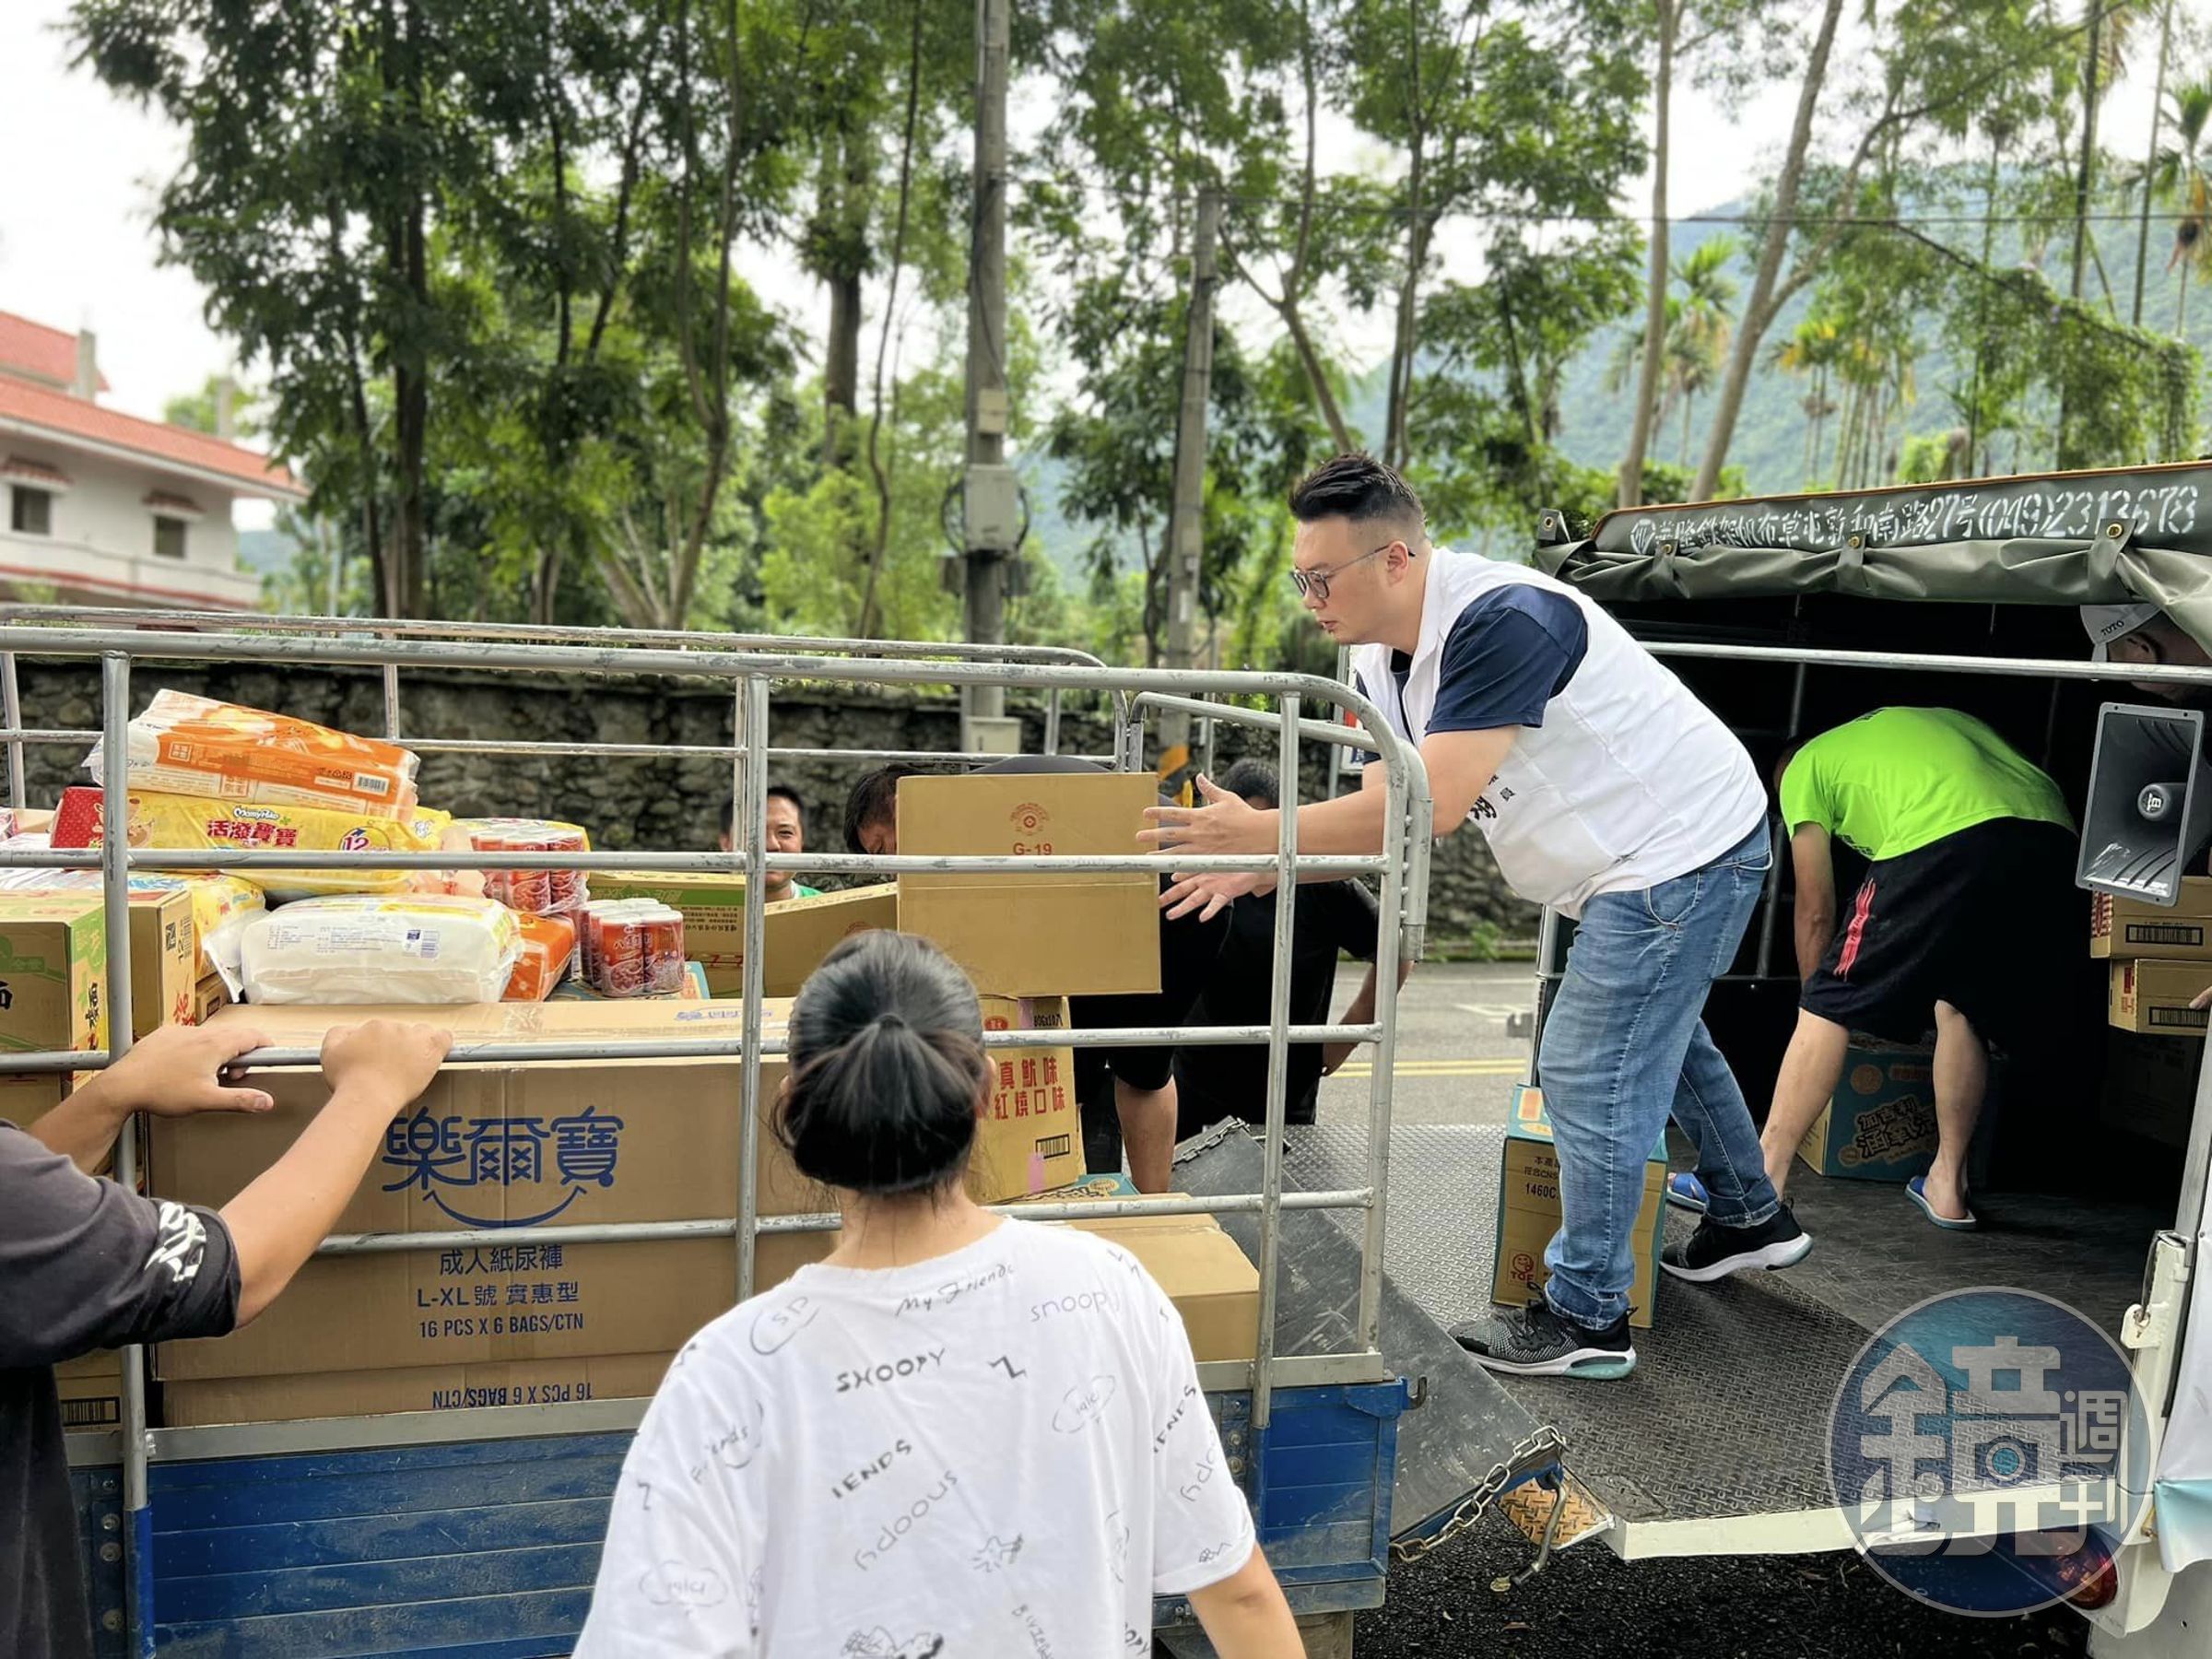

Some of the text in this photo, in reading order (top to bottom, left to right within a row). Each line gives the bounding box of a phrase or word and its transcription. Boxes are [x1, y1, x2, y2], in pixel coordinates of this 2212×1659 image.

[1013, 842, 1053, 855] G-19
[999, 1056, 1059, 1089] 真魷味
[994, 1087, 1065, 1120] 紅燒口味
[382, 1106, 624, 1192] 樂爾寶
[440, 1245, 563, 1276] 成人紙尿褲
[506, 1281, 579, 1306] 實惠型
[420, 1313, 583, 1338] 16 PCS X 6 BAGS/CTN
